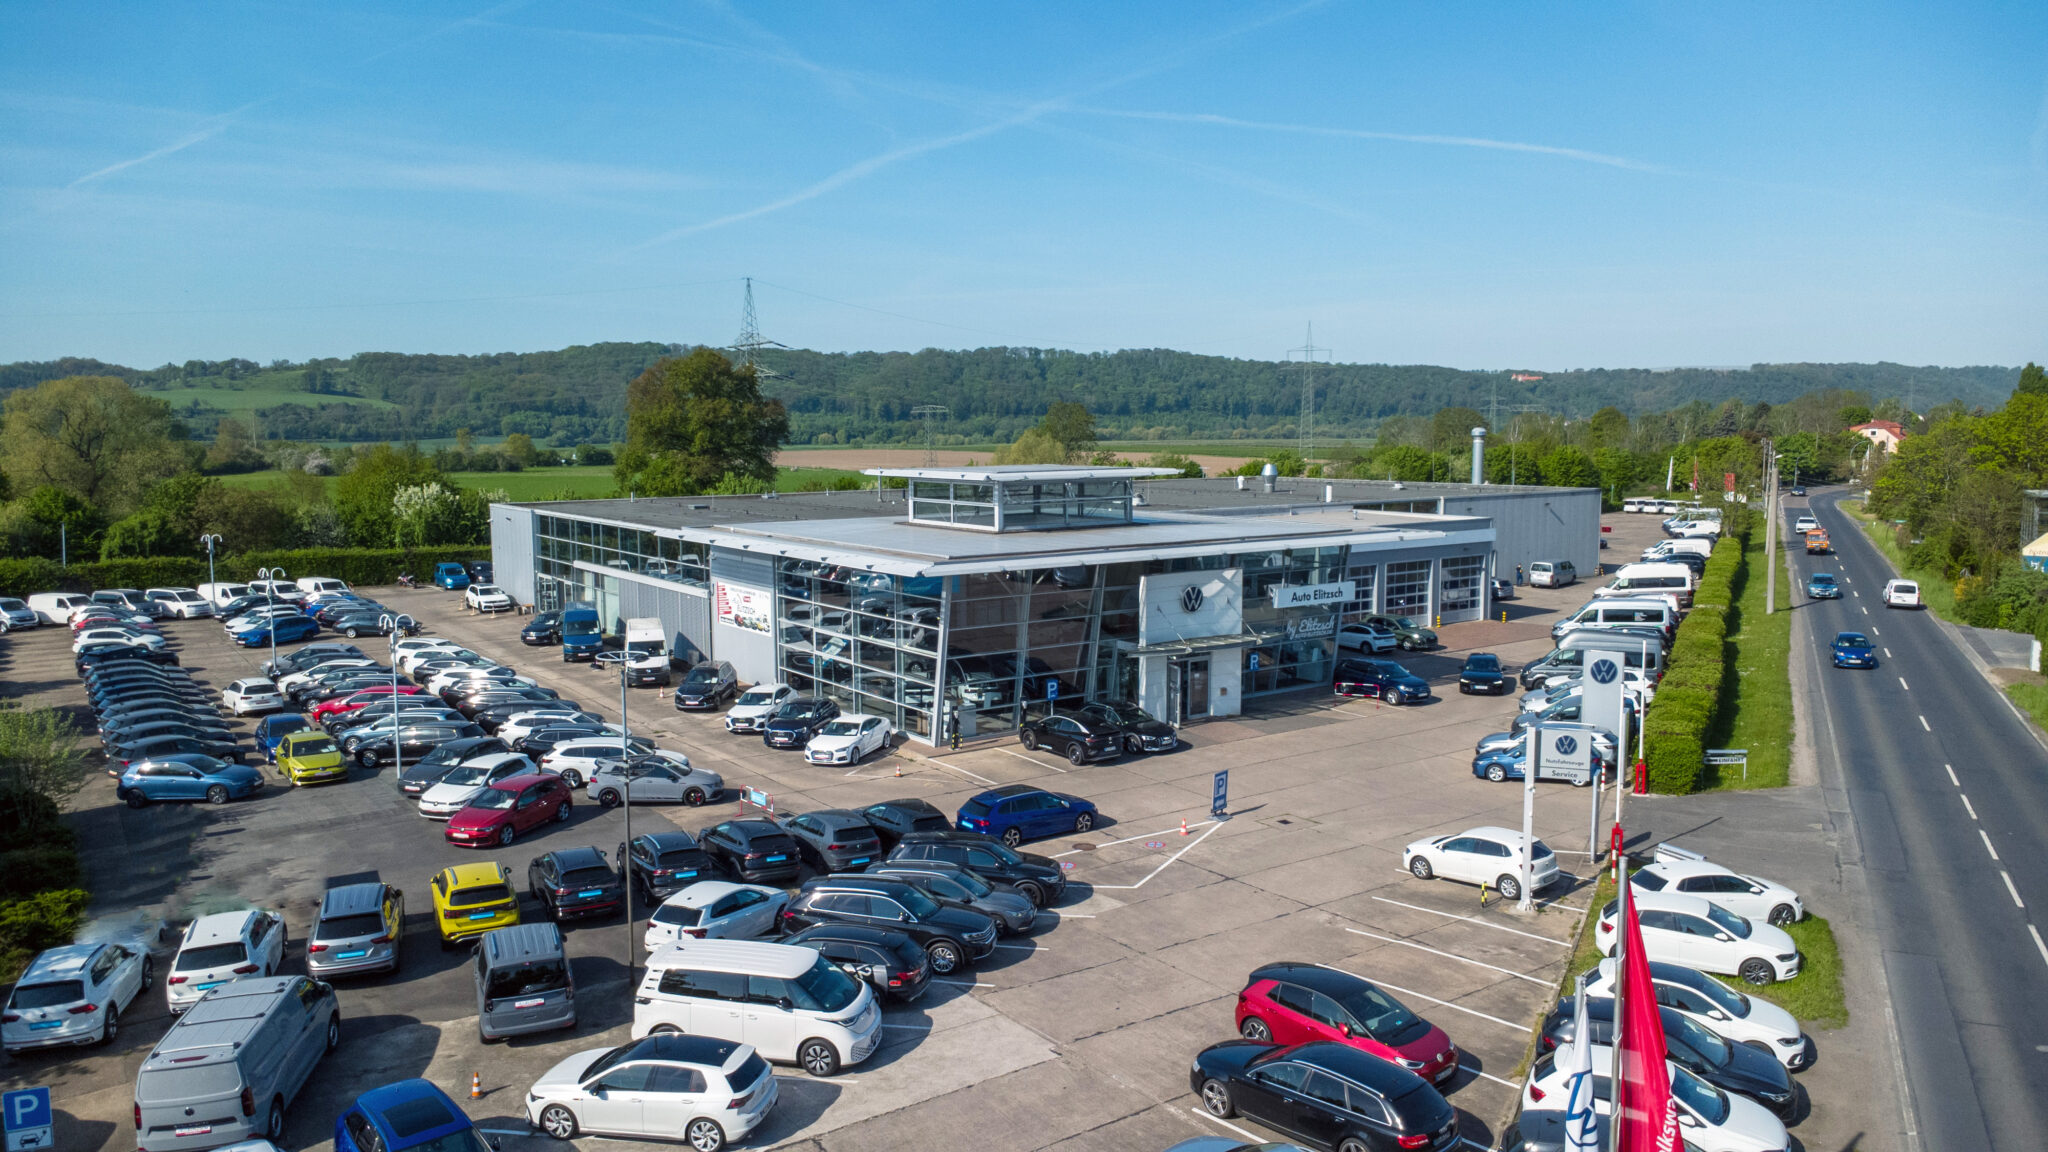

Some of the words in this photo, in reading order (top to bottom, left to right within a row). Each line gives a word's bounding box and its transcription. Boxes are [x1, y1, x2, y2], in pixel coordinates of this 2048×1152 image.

[1291, 591, 1311, 602] Auto
[1314, 587, 1343, 600] Elitzsch
[1551, 770, 1578, 778] Service
[1217, 777, 1225, 795] P
[14, 1095, 39, 1125] P
